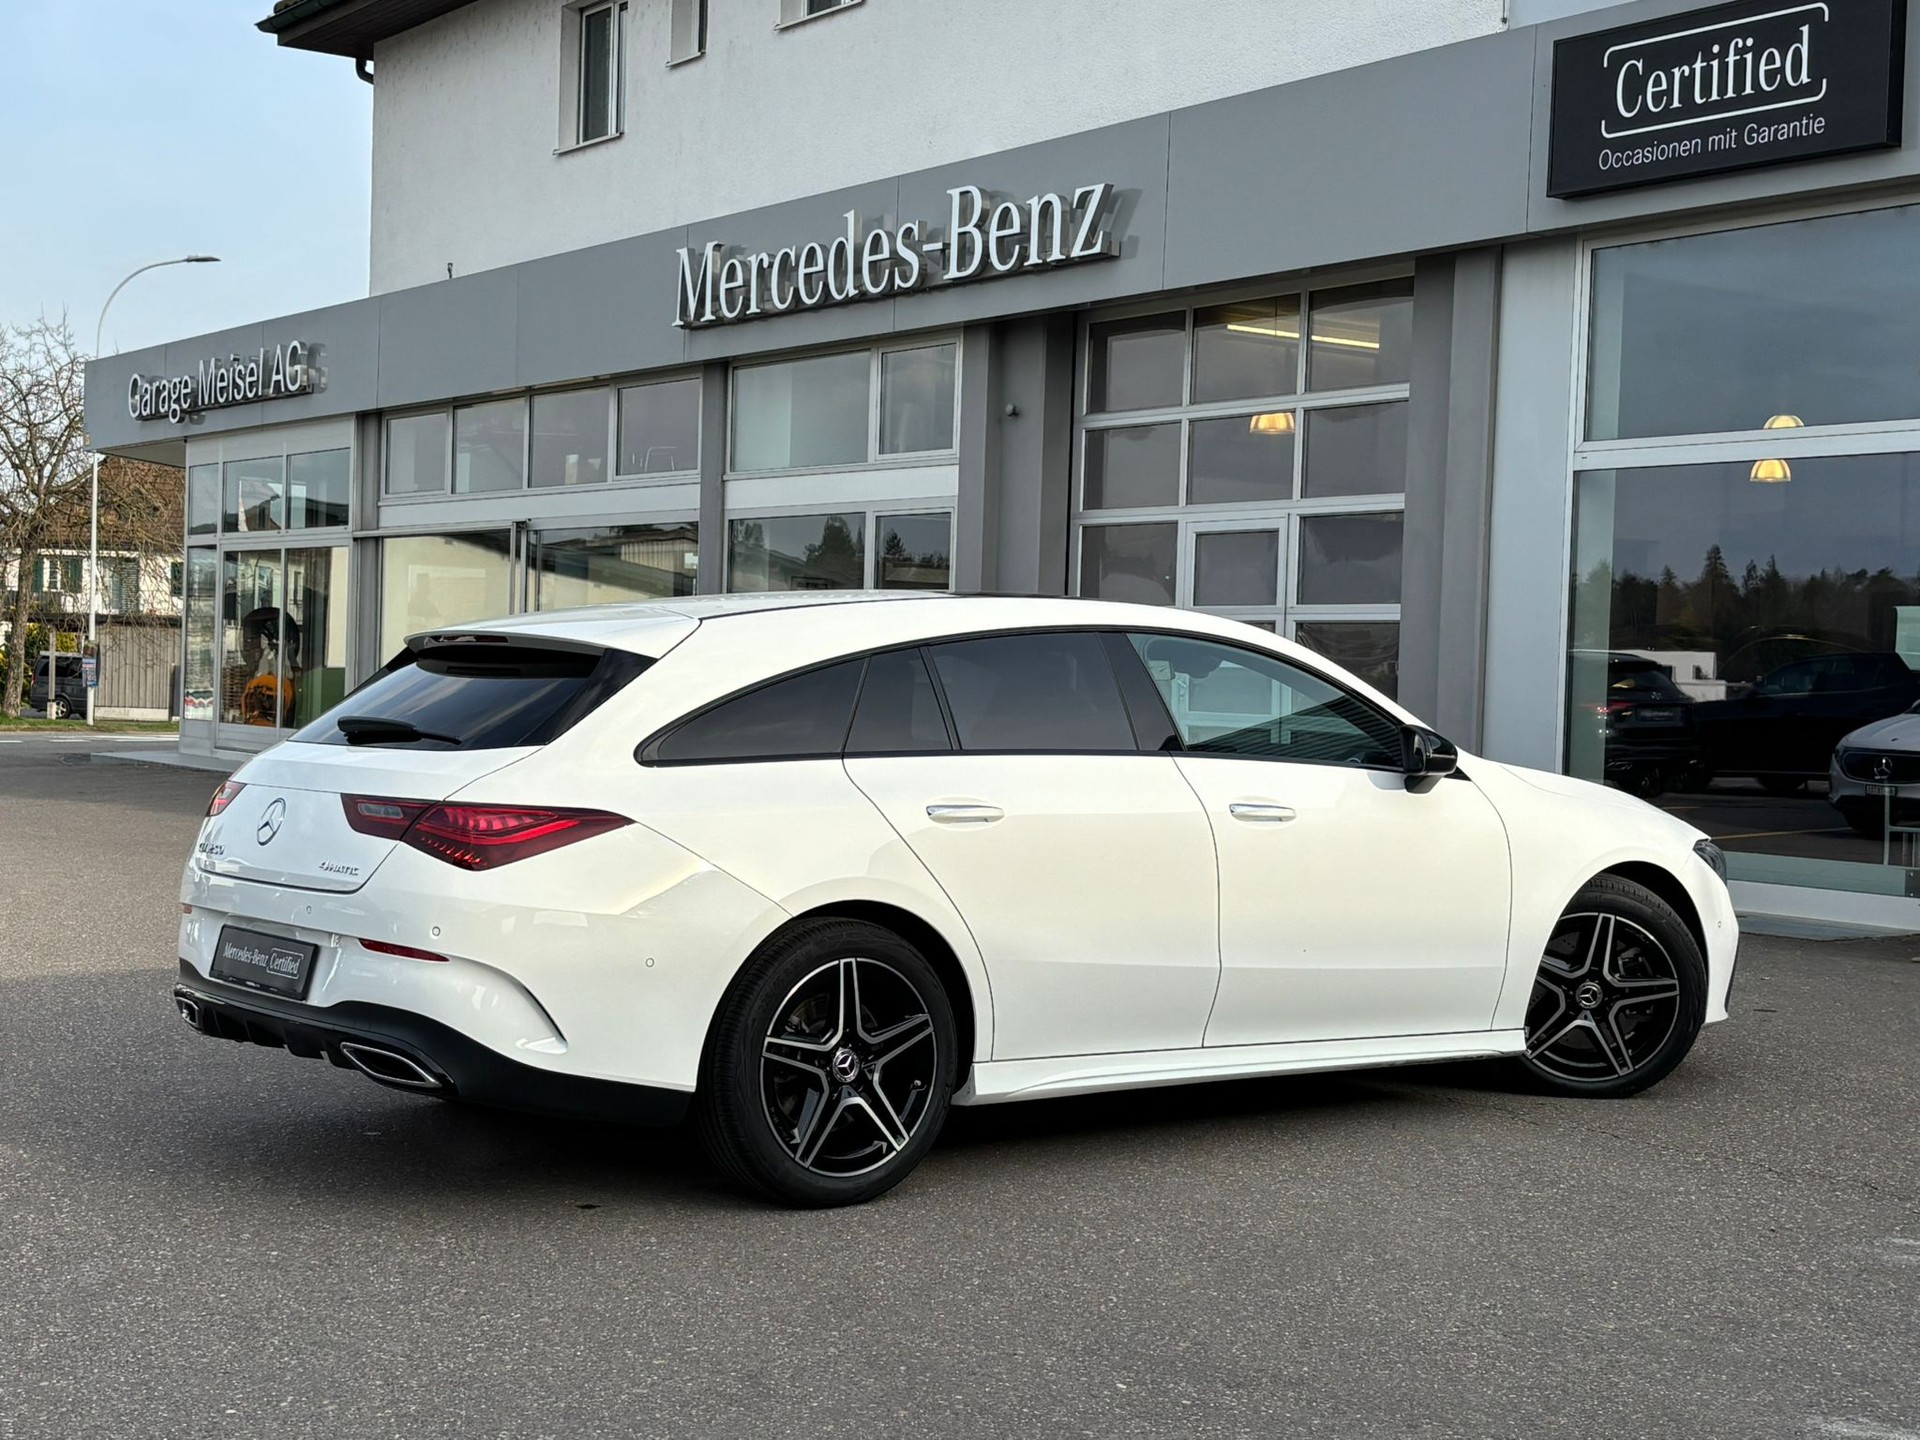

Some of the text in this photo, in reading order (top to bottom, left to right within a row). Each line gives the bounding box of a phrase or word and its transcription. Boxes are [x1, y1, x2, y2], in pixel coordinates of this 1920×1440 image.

[1616, 24, 1812, 118] Certified
[1598, 113, 1826, 170] Occasionen mit Garantie
[671, 183, 1109, 327] Mercedes-Benz
[128, 339, 303, 424] Garage Meisel AG
[319, 860, 360, 876] 4MATIC
[222, 941, 301, 975] Mercedes-Benz Certified
